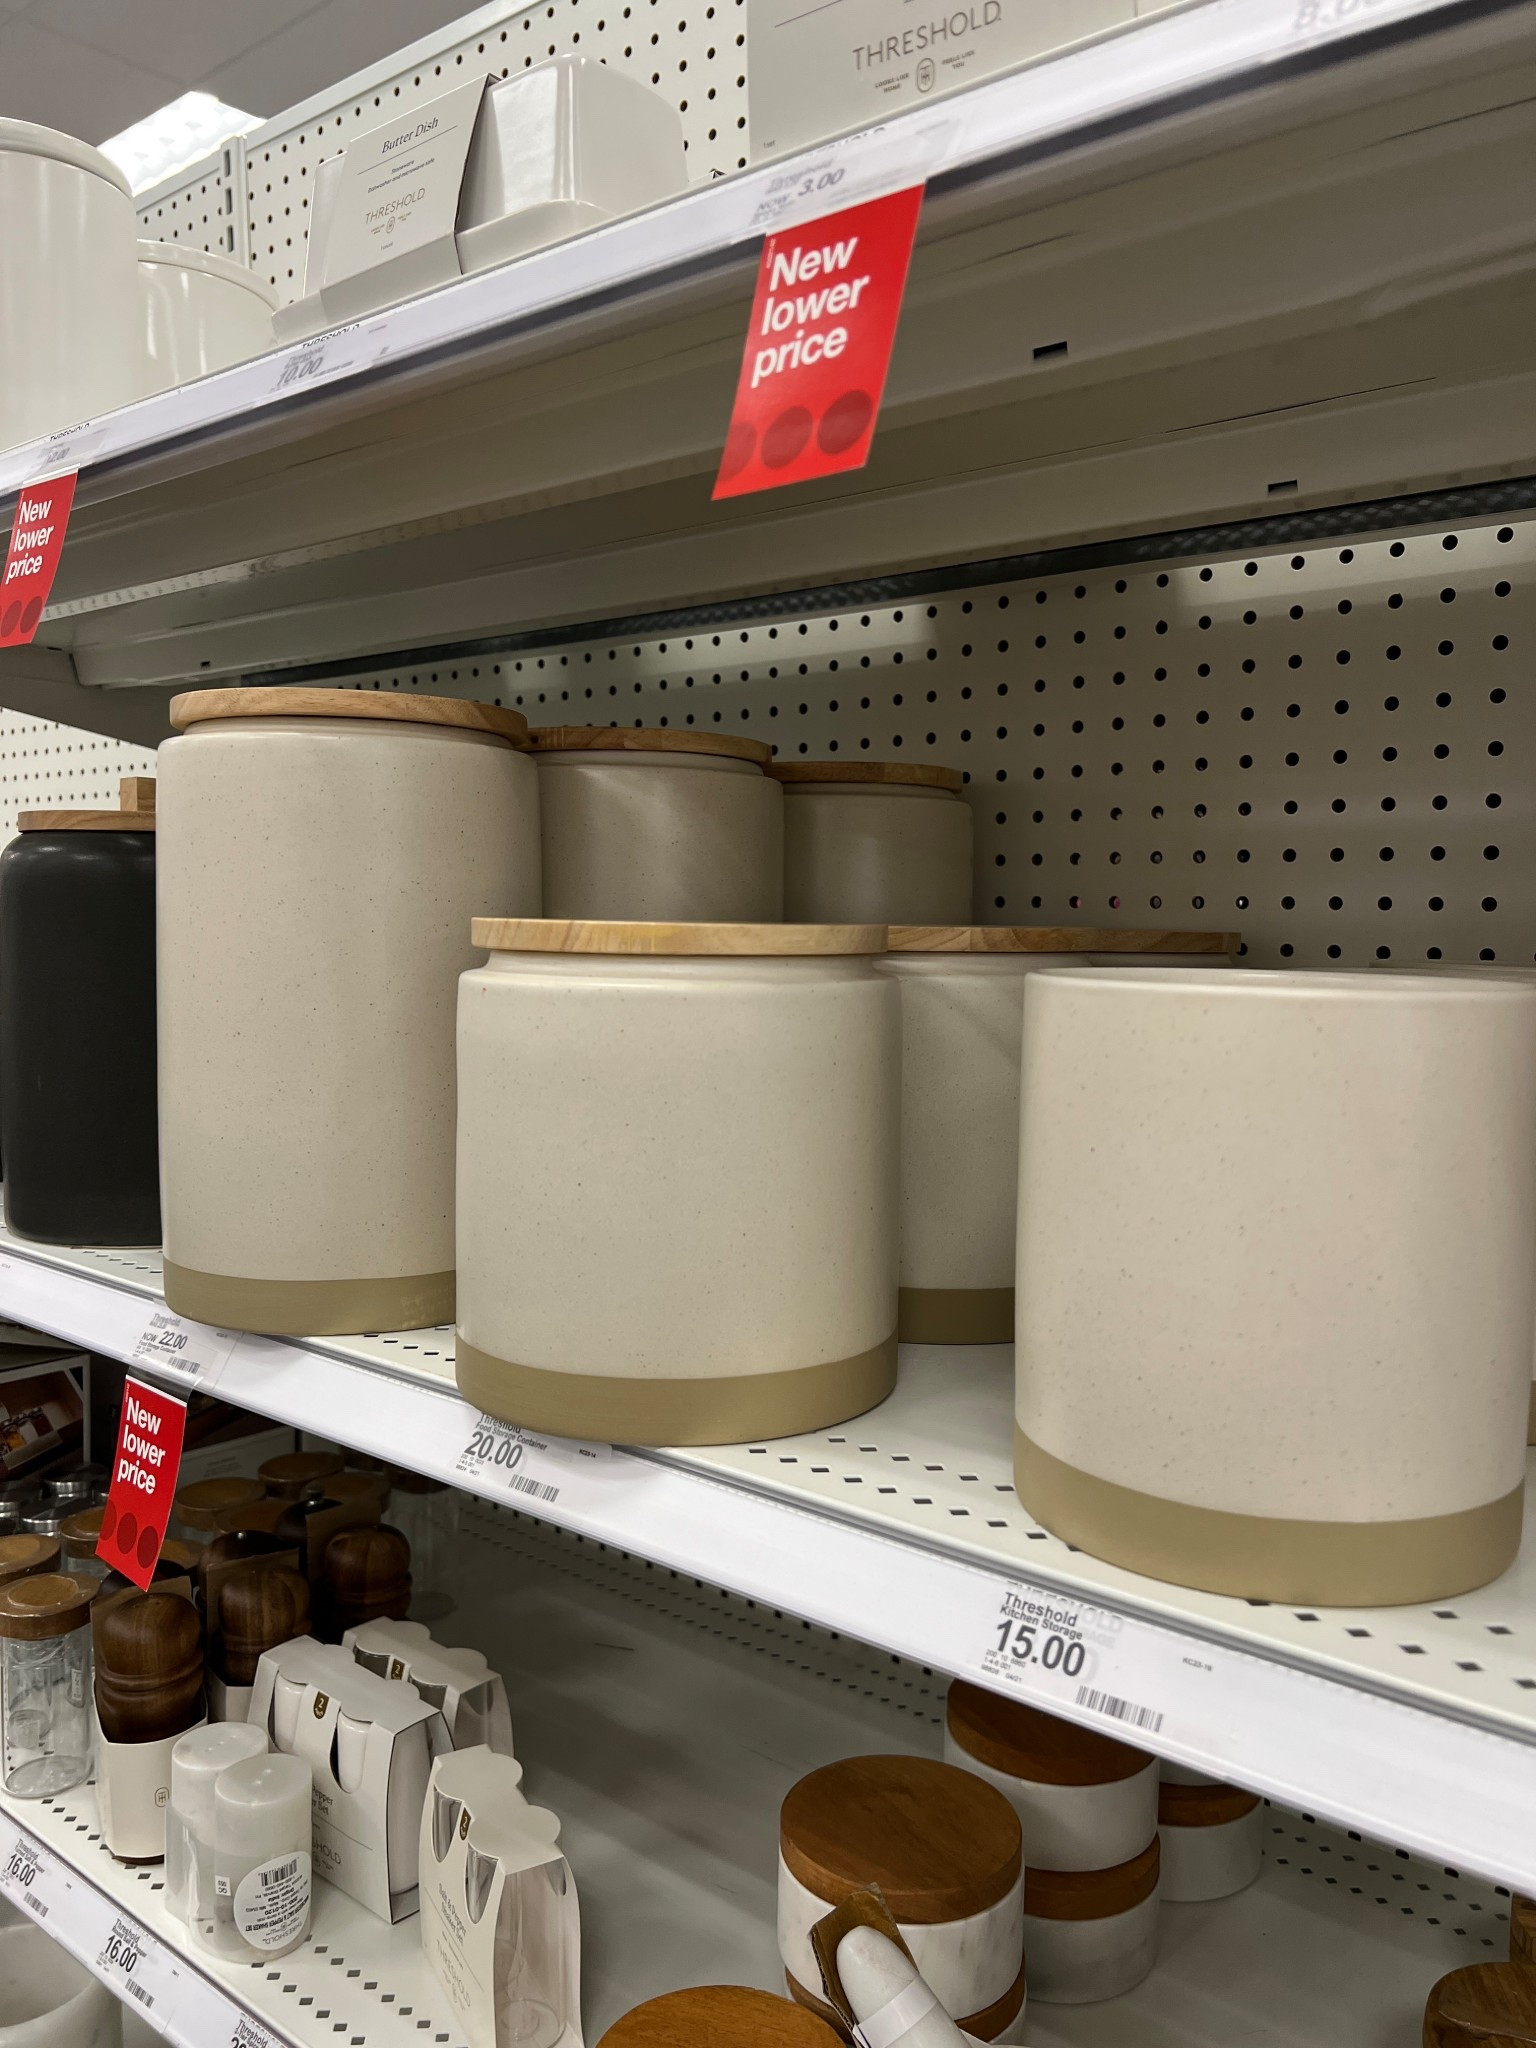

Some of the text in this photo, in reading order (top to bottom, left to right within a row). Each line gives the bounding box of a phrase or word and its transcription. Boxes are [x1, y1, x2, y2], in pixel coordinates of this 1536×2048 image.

[851, 0, 1001, 71] THRESHOLD
[381, 117, 439, 154] Butter Dish
[797, 167, 847, 197] 3.00
[365, 187, 427, 225] THRESHOLD
[769, 237, 859, 292] New
[761, 275, 871, 337] lower
[276, 355, 324, 387] 10.00
[750, 326, 848, 390] price
[18, 499, 52, 525] New
[13, 525, 54, 553] lower
[5, 552, 43, 585] price
[141, 1330, 188, 1350] NOW 22.00
[126, 1396, 162, 1435] New
[480, 1413, 522, 1434] Threshold
[122, 1424, 166, 1468] lower
[464, 1430, 523, 1469] 20.00
[476, 1422, 548, 1451] Food Storage Container
[117, 1458, 156, 1495] price
[1000, 1604, 1040, 1625] Kitchen
[1041, 1619, 1083, 1641] Storage
[1004, 1592, 1078, 1628] Threshold
[996, 1619, 1086, 1677] 15.00
[317, 1697, 324, 1709] 2
[312, 1784, 334, 1806] Pepper
[317, 1801, 329, 1816] Set
[15, 1838, 39, 1860] Threshold
[6, 1853, 36, 1886] 16.00
[112, 1918, 141, 1943] Threshold
[264, 1921, 302, 1944] THRESHOLD
[105, 1935, 137, 1972] 16.00
[235, 2018, 269, 2048] Threshold
